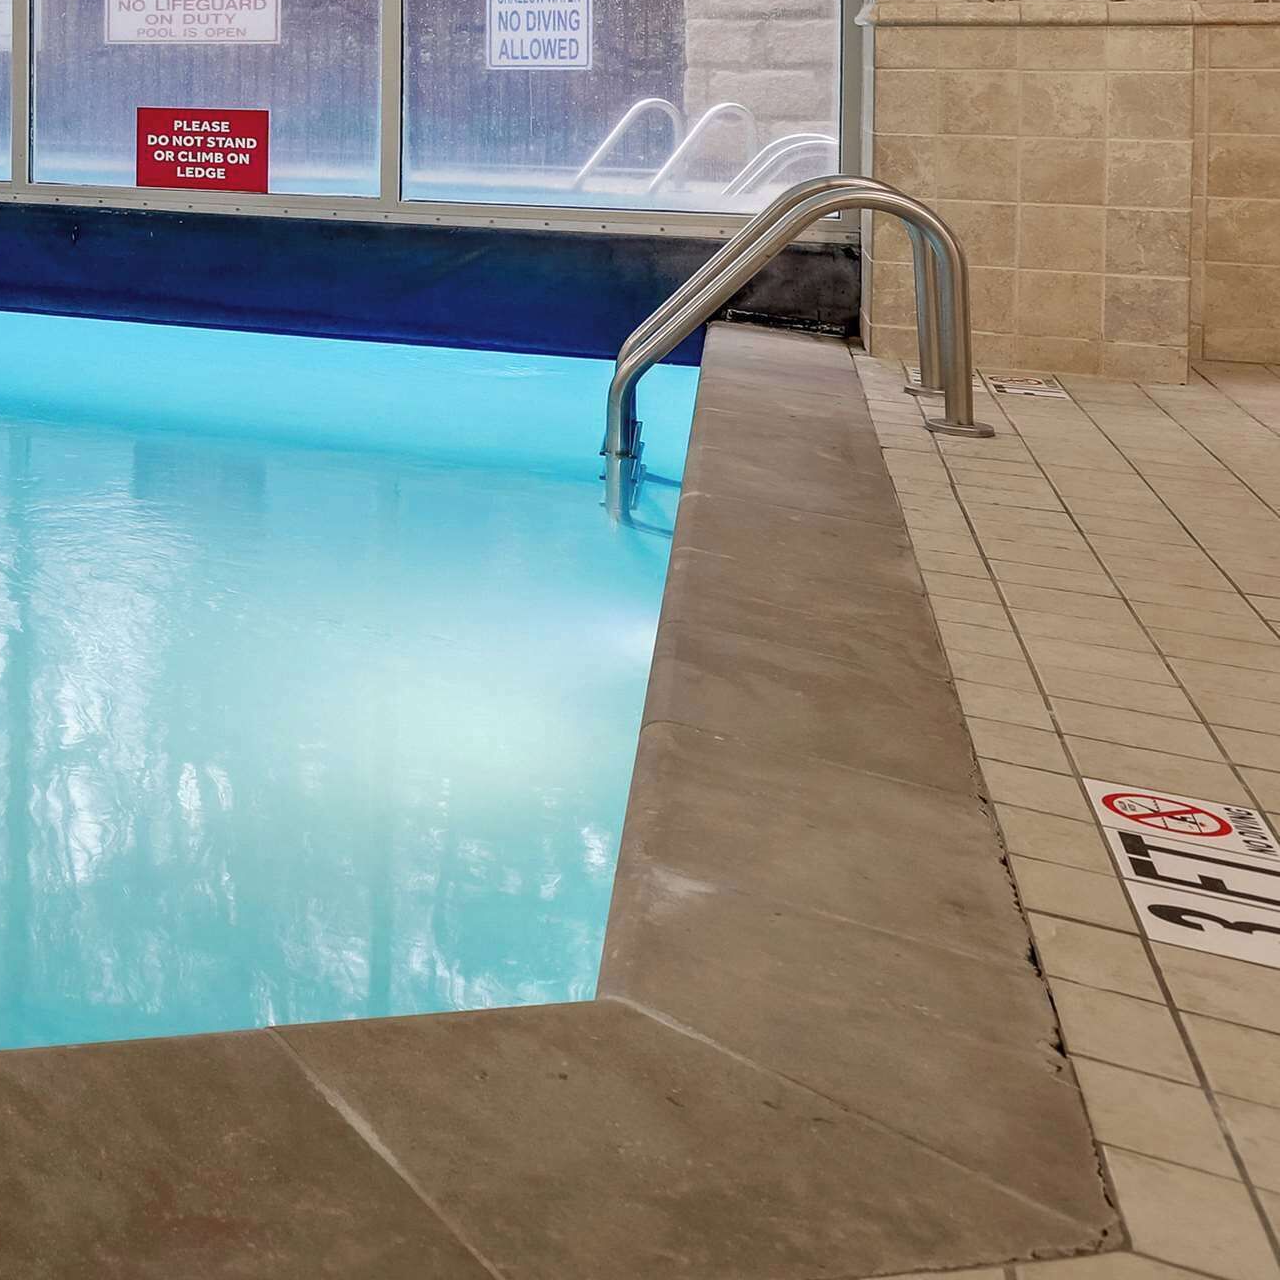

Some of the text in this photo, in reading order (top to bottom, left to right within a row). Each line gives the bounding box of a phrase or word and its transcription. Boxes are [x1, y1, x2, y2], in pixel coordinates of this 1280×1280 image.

[118, 0, 146, 12] NO
[145, 13, 237, 25] ON DUTY
[498, 9, 581, 32] NO DIVING
[136, 27, 247, 38] POOL IS OPEN
[498, 38, 580, 60] ALLOWED
[173, 120, 230, 132] PLEASE
[147, 134, 257, 149] DO NOT STAND
[153, 150, 250, 164] OR CLIMB ON
[176, 166, 226, 179] LEDGE
[1223, 807, 1280, 857] NO DIVING
[1118, 830, 1280, 907] FT
